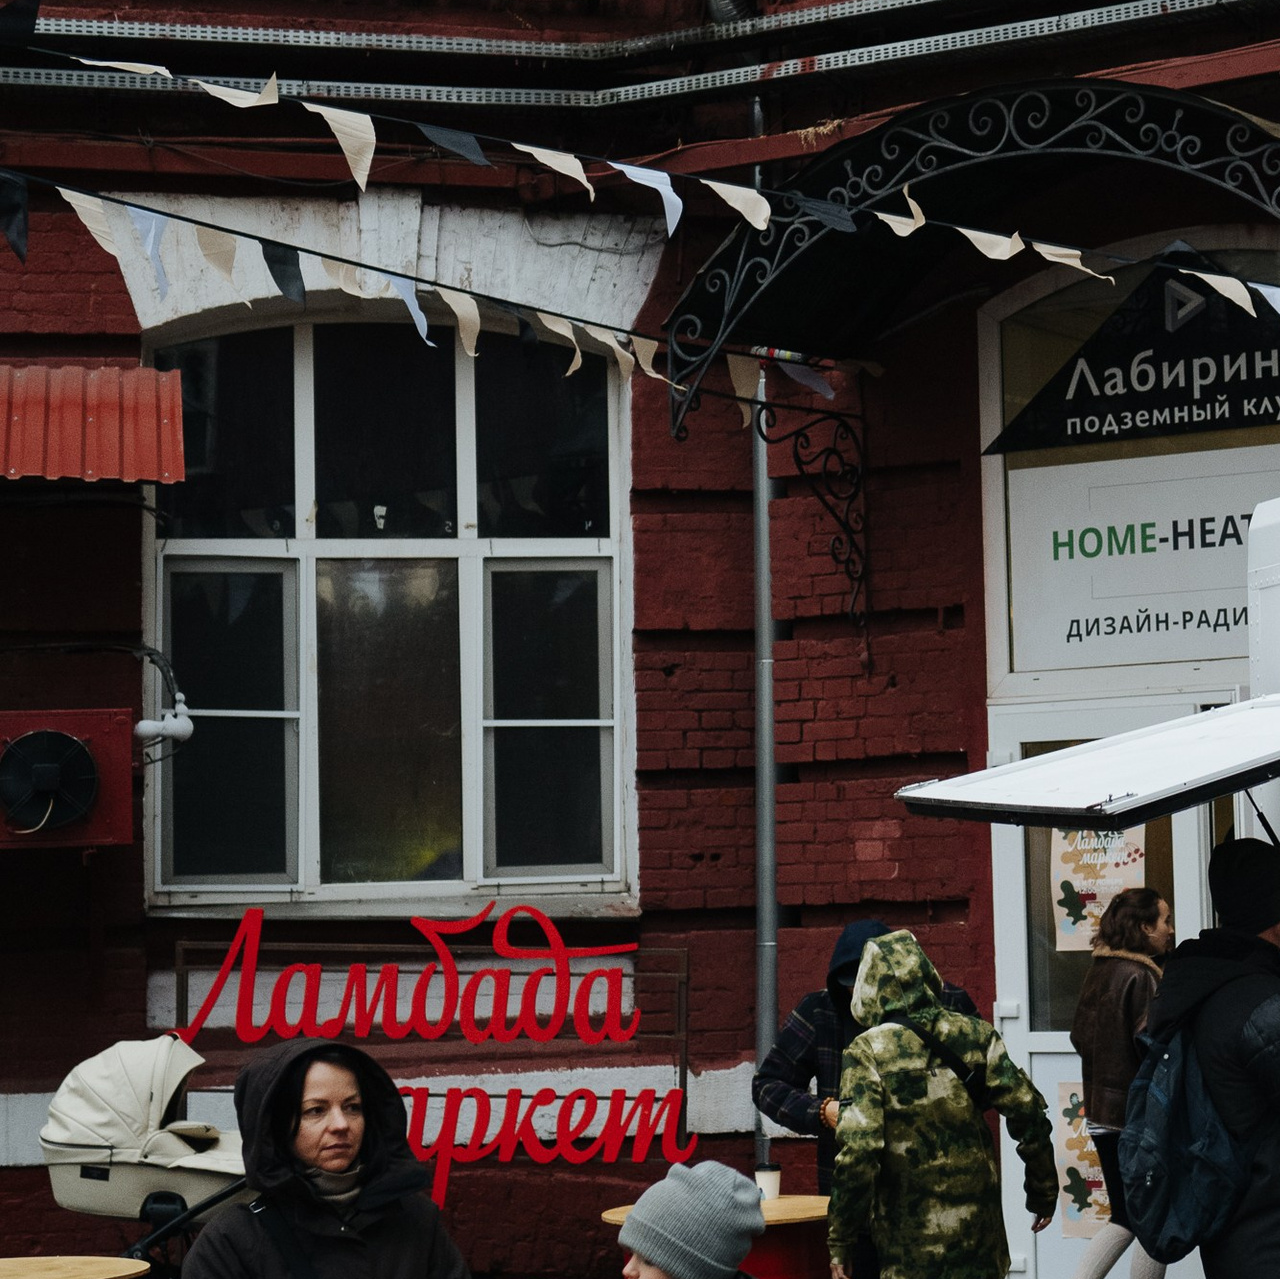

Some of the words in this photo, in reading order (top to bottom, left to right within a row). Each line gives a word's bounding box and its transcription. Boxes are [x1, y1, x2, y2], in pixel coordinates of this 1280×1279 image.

[1066, 394, 1230, 435] подземный
[165, 900, 641, 1046] Ламбада
[398, 1086, 698, 1211] аркет
